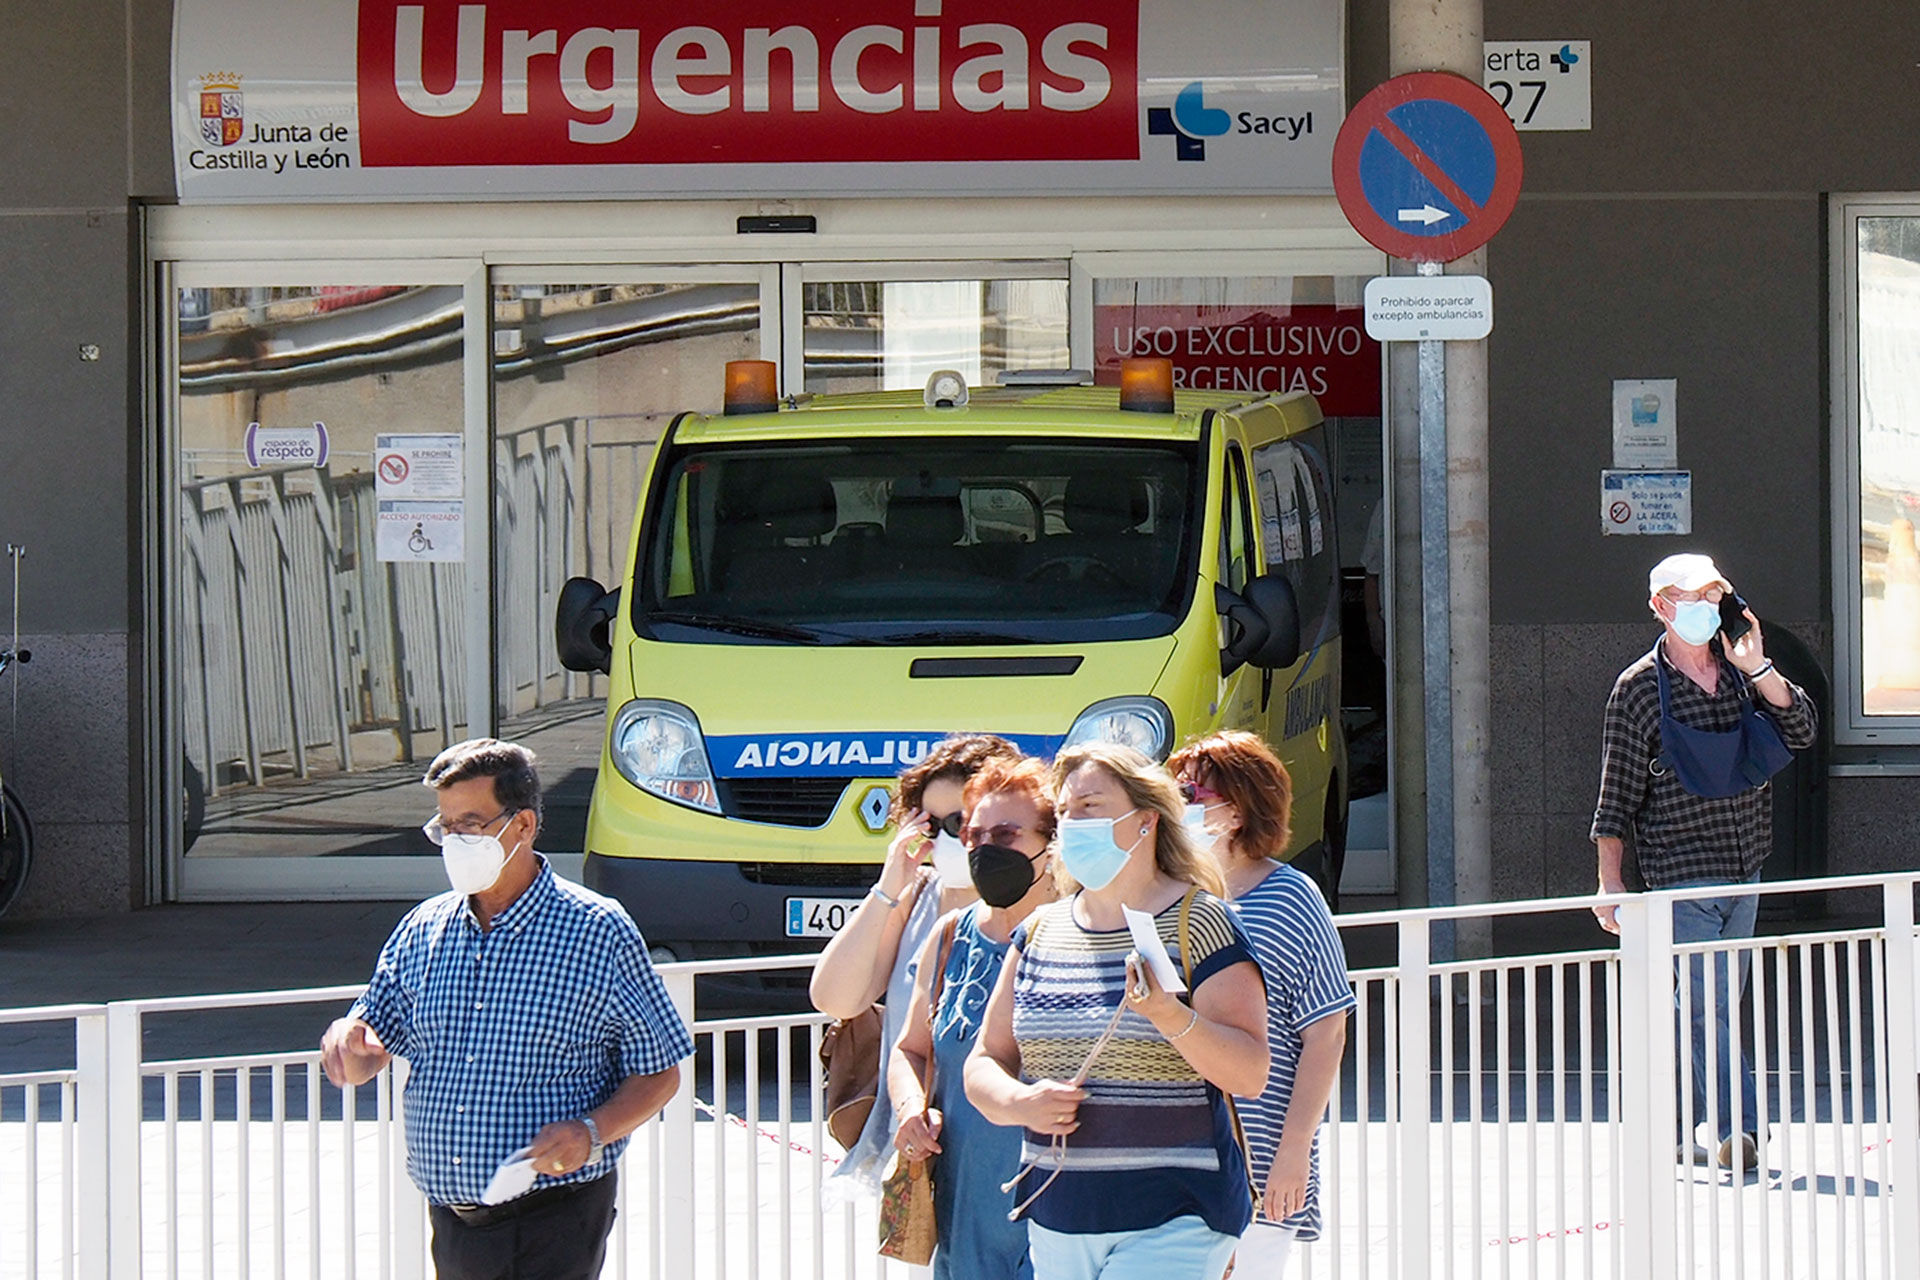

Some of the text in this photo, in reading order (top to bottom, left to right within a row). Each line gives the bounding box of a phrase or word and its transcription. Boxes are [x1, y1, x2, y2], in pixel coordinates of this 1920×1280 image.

[394, 1, 1112, 144] Urgencias
[1484, 48, 1539, 71] erta
[249, 123, 348, 142] Junta de
[1237, 111, 1313, 140] Sacyl
[189, 147, 350, 174] Castilla y León
[1372, 308, 1484, 321] excepto ambulancias
[1380, 296, 1474, 308] Prohibido aparcar
[1114, 326, 1362, 355] USO EXCLUSIVO
[1172, 366, 1328, 396] RGENCIAS
[261, 446, 314, 460] respeto
[808, 904, 859, 932] 40
